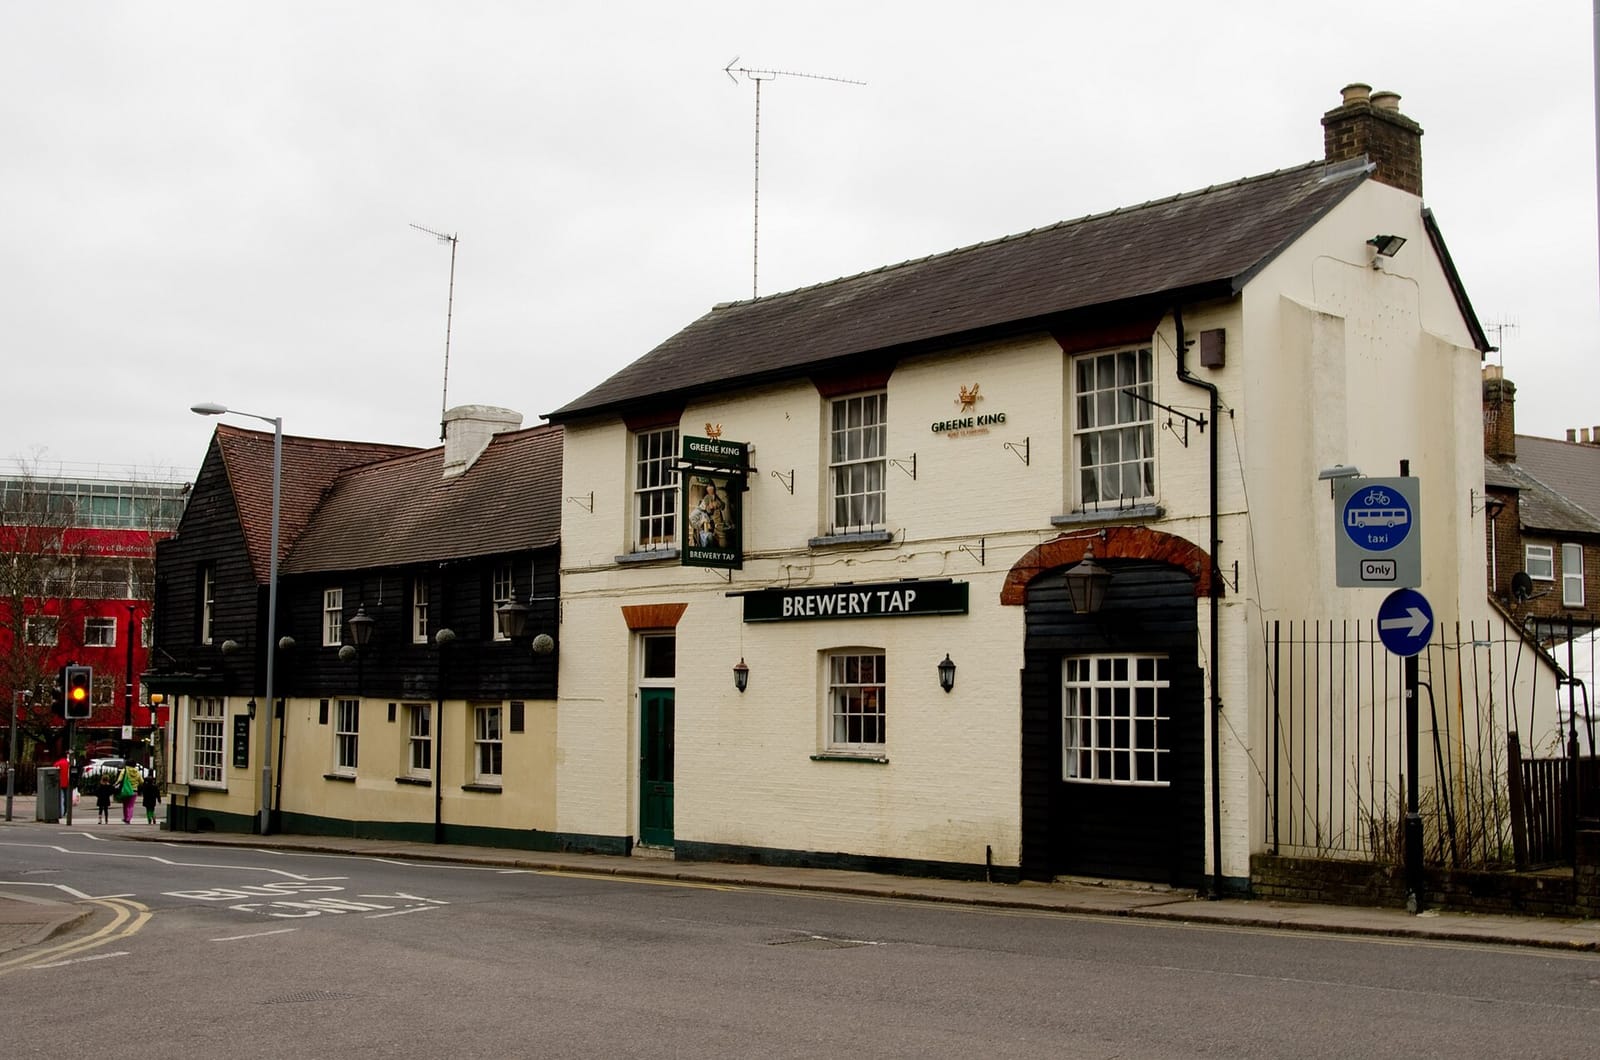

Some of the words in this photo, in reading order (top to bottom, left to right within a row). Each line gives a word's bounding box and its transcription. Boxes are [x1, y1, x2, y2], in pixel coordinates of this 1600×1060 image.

[931, 417, 974, 433] GREENE
[976, 412, 1006, 427] KING
[689, 442, 720, 453] GREENE
[720, 446, 740, 456] KING
[1367, 533, 1389, 544] taxi
[689, 550, 721, 560] BREWERY
[722, 552, 735, 561] TAP
[1366, 564, 1391, 576] Only
[782, 592, 873, 618] BREWERY
[876, 589, 917, 613] TAP
[159, 882, 345, 901] BUS
